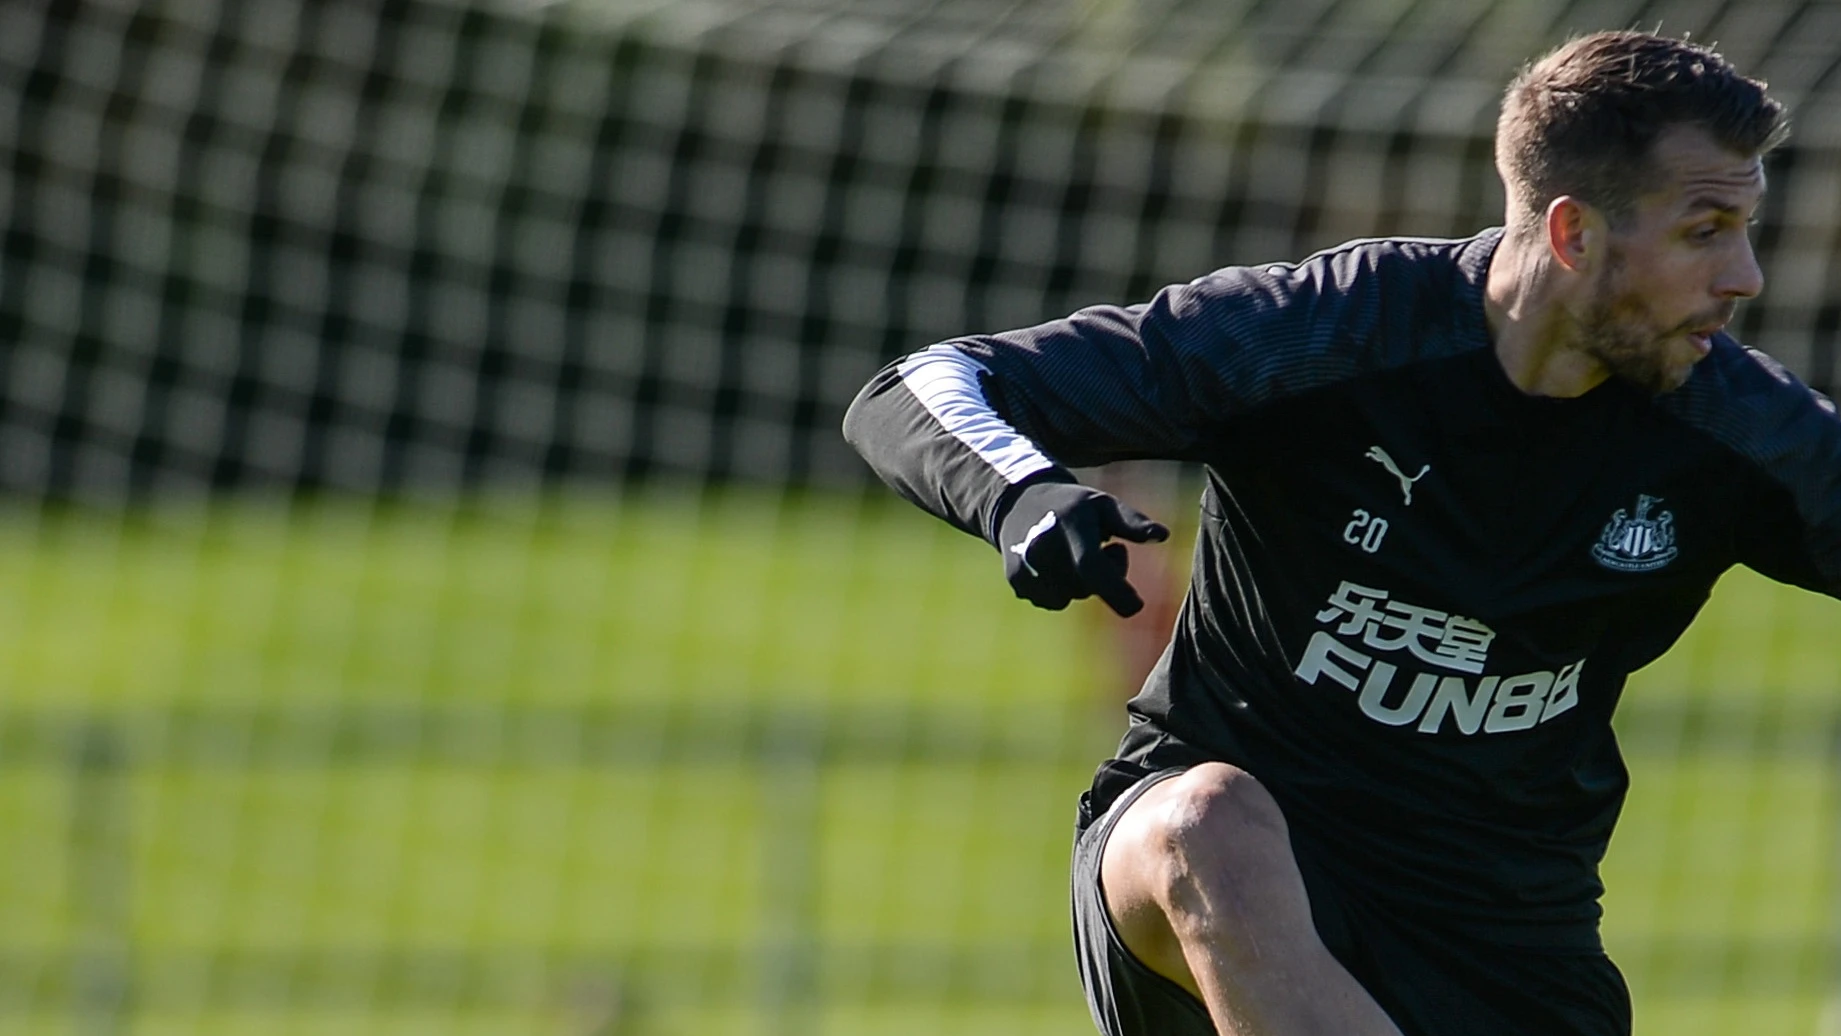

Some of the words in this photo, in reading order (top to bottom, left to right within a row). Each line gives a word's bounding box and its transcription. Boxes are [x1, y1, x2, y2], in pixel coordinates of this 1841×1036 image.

[1343, 508, 1389, 553] 20
[1315, 580, 1497, 675] 乐天堂
